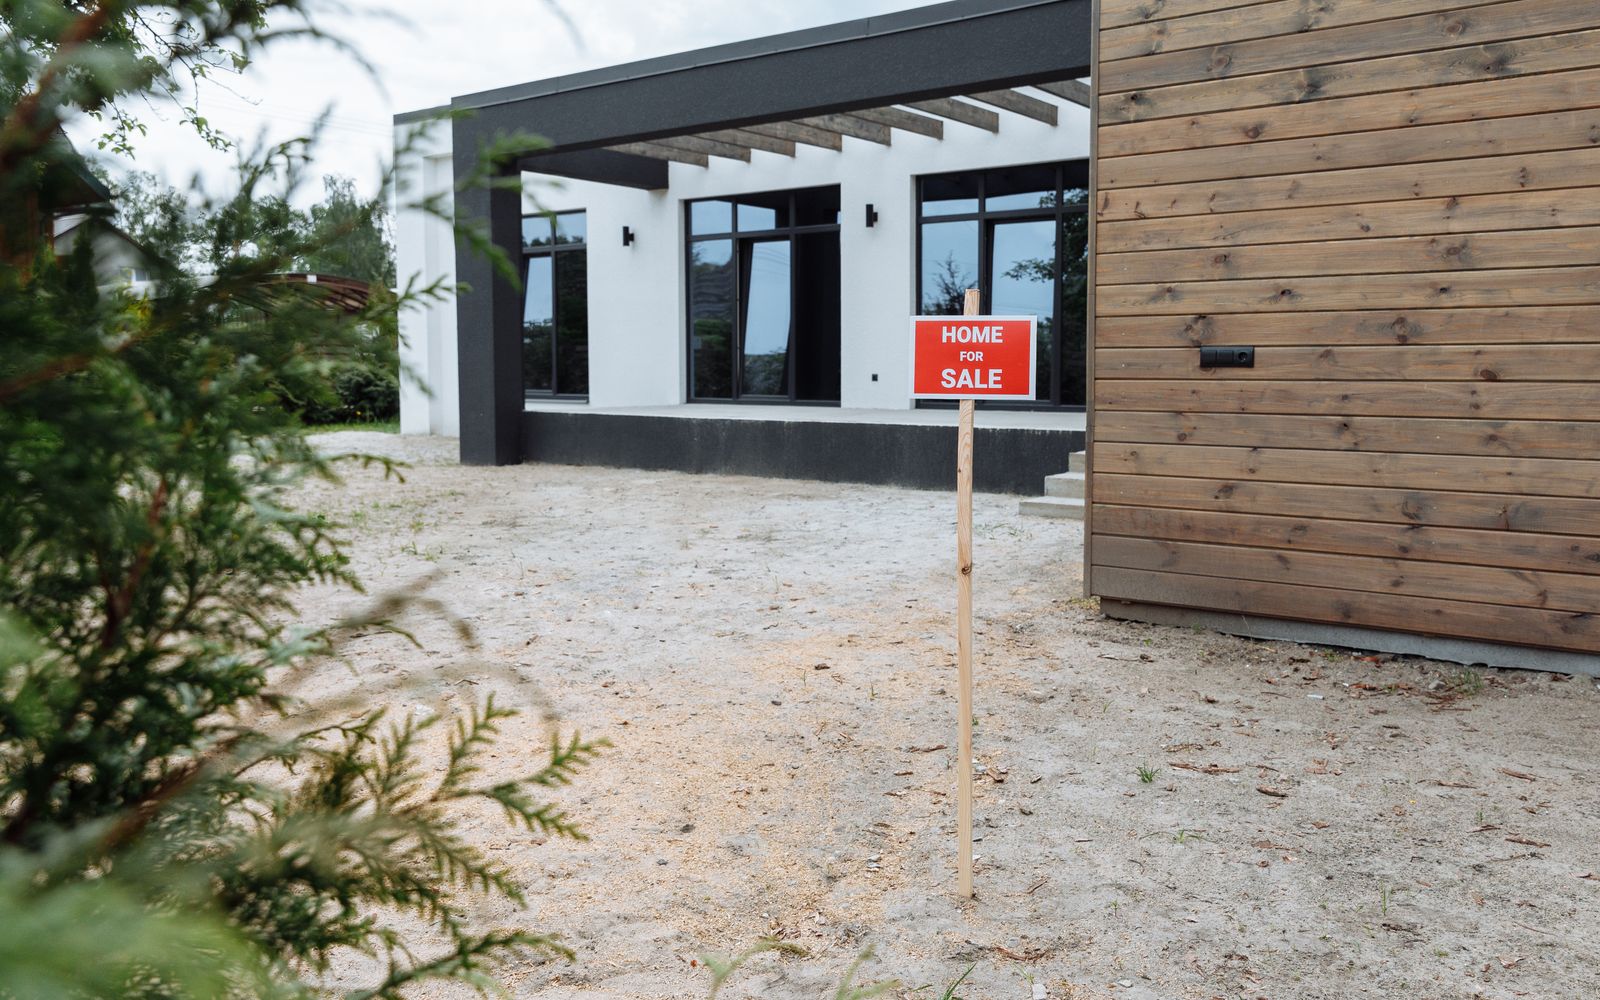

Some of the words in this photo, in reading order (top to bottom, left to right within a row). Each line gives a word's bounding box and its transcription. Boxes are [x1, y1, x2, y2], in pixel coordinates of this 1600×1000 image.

[941, 326, 1004, 343] HOME
[959, 351, 984, 362] FOR
[940, 368, 1003, 389] SALE
